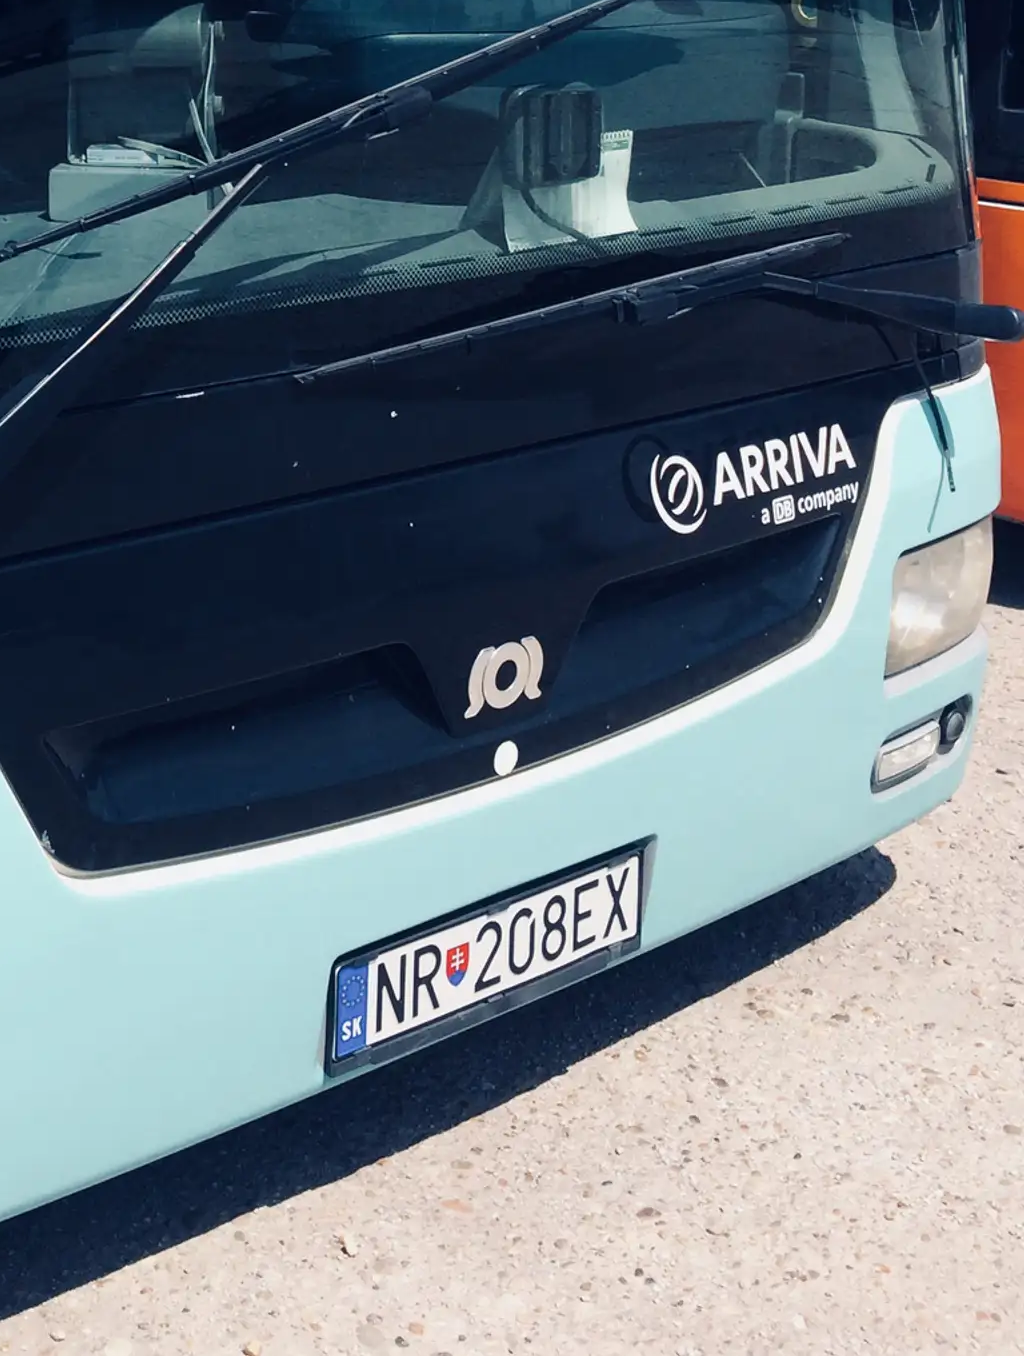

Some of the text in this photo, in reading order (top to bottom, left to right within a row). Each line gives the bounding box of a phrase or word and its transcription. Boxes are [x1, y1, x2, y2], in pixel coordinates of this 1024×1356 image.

[713, 423, 857, 507] ARRIVA
[761, 481, 860, 525] a DB company
[375, 867, 630, 1034] NR 208EX
[341, 1015, 363, 1042] SK
